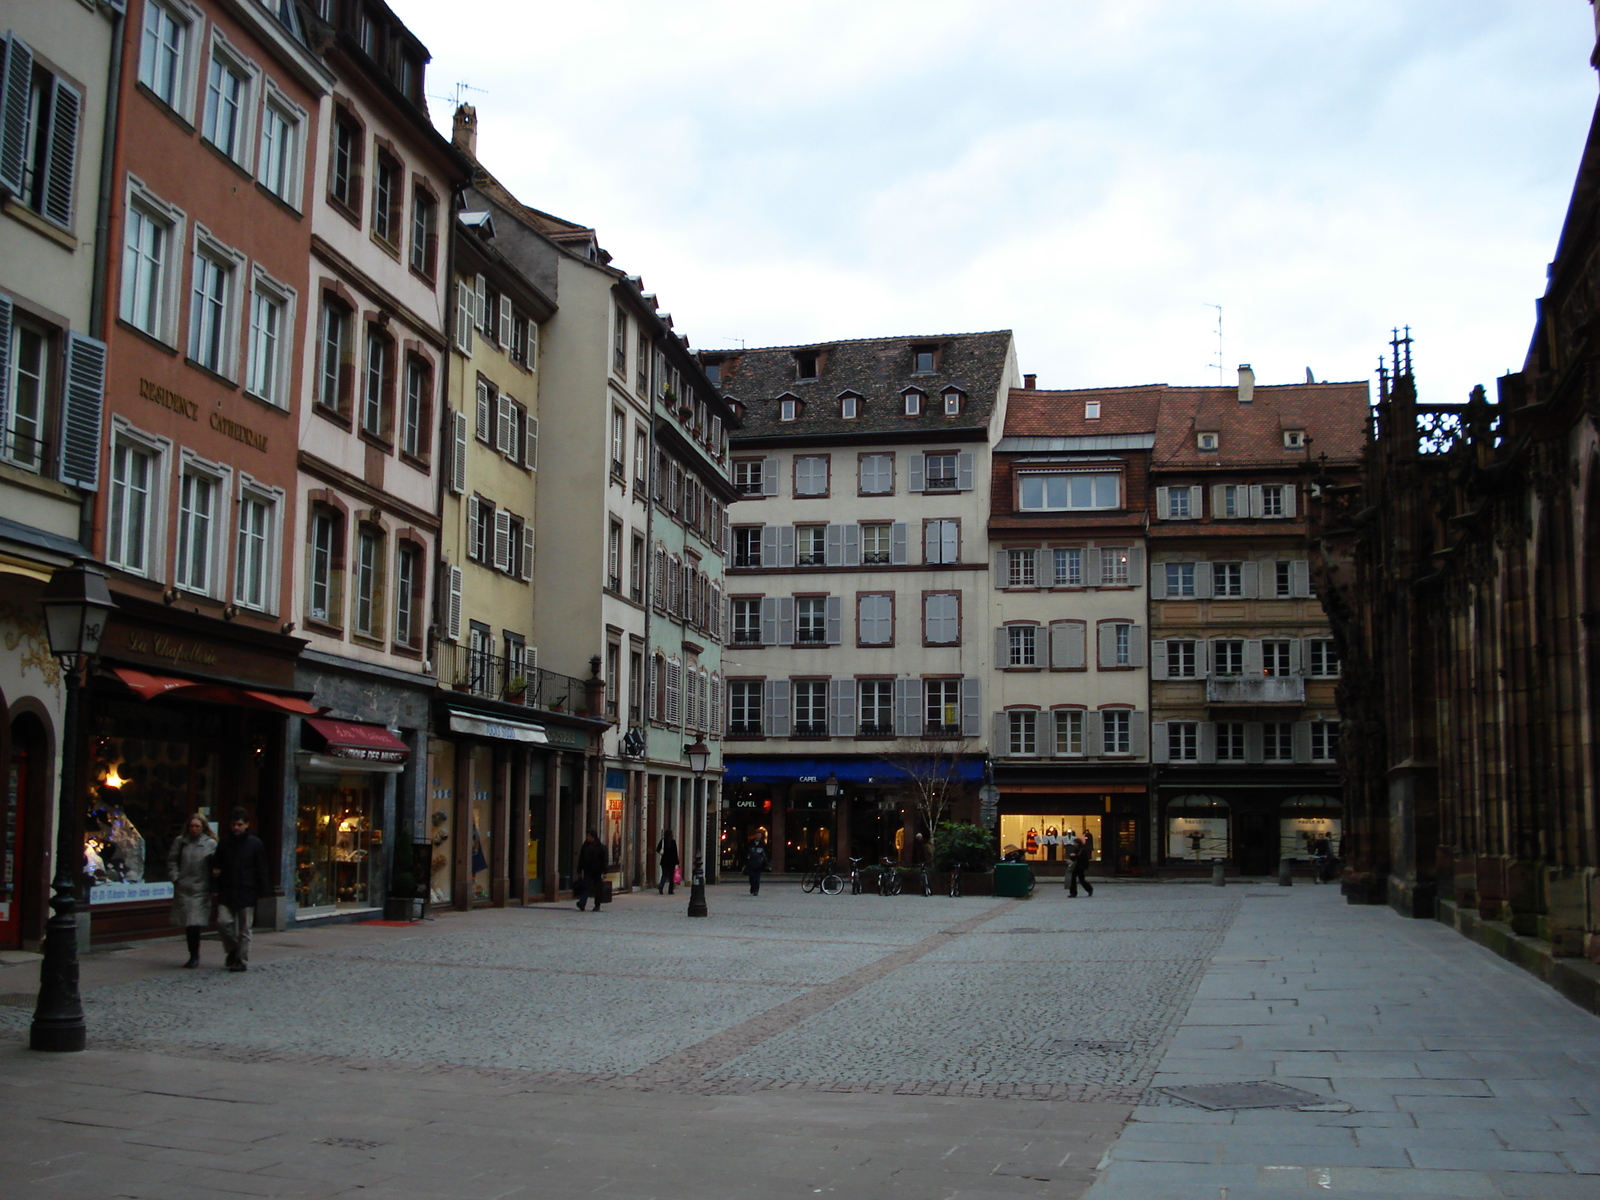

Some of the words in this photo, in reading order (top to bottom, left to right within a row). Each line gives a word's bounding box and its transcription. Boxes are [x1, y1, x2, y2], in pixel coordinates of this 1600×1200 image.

[139, 378, 199, 422] RESIDENCE
[209, 412, 269, 454] CATHEDRALE
[736, 800, 757, 808] CAPEL
